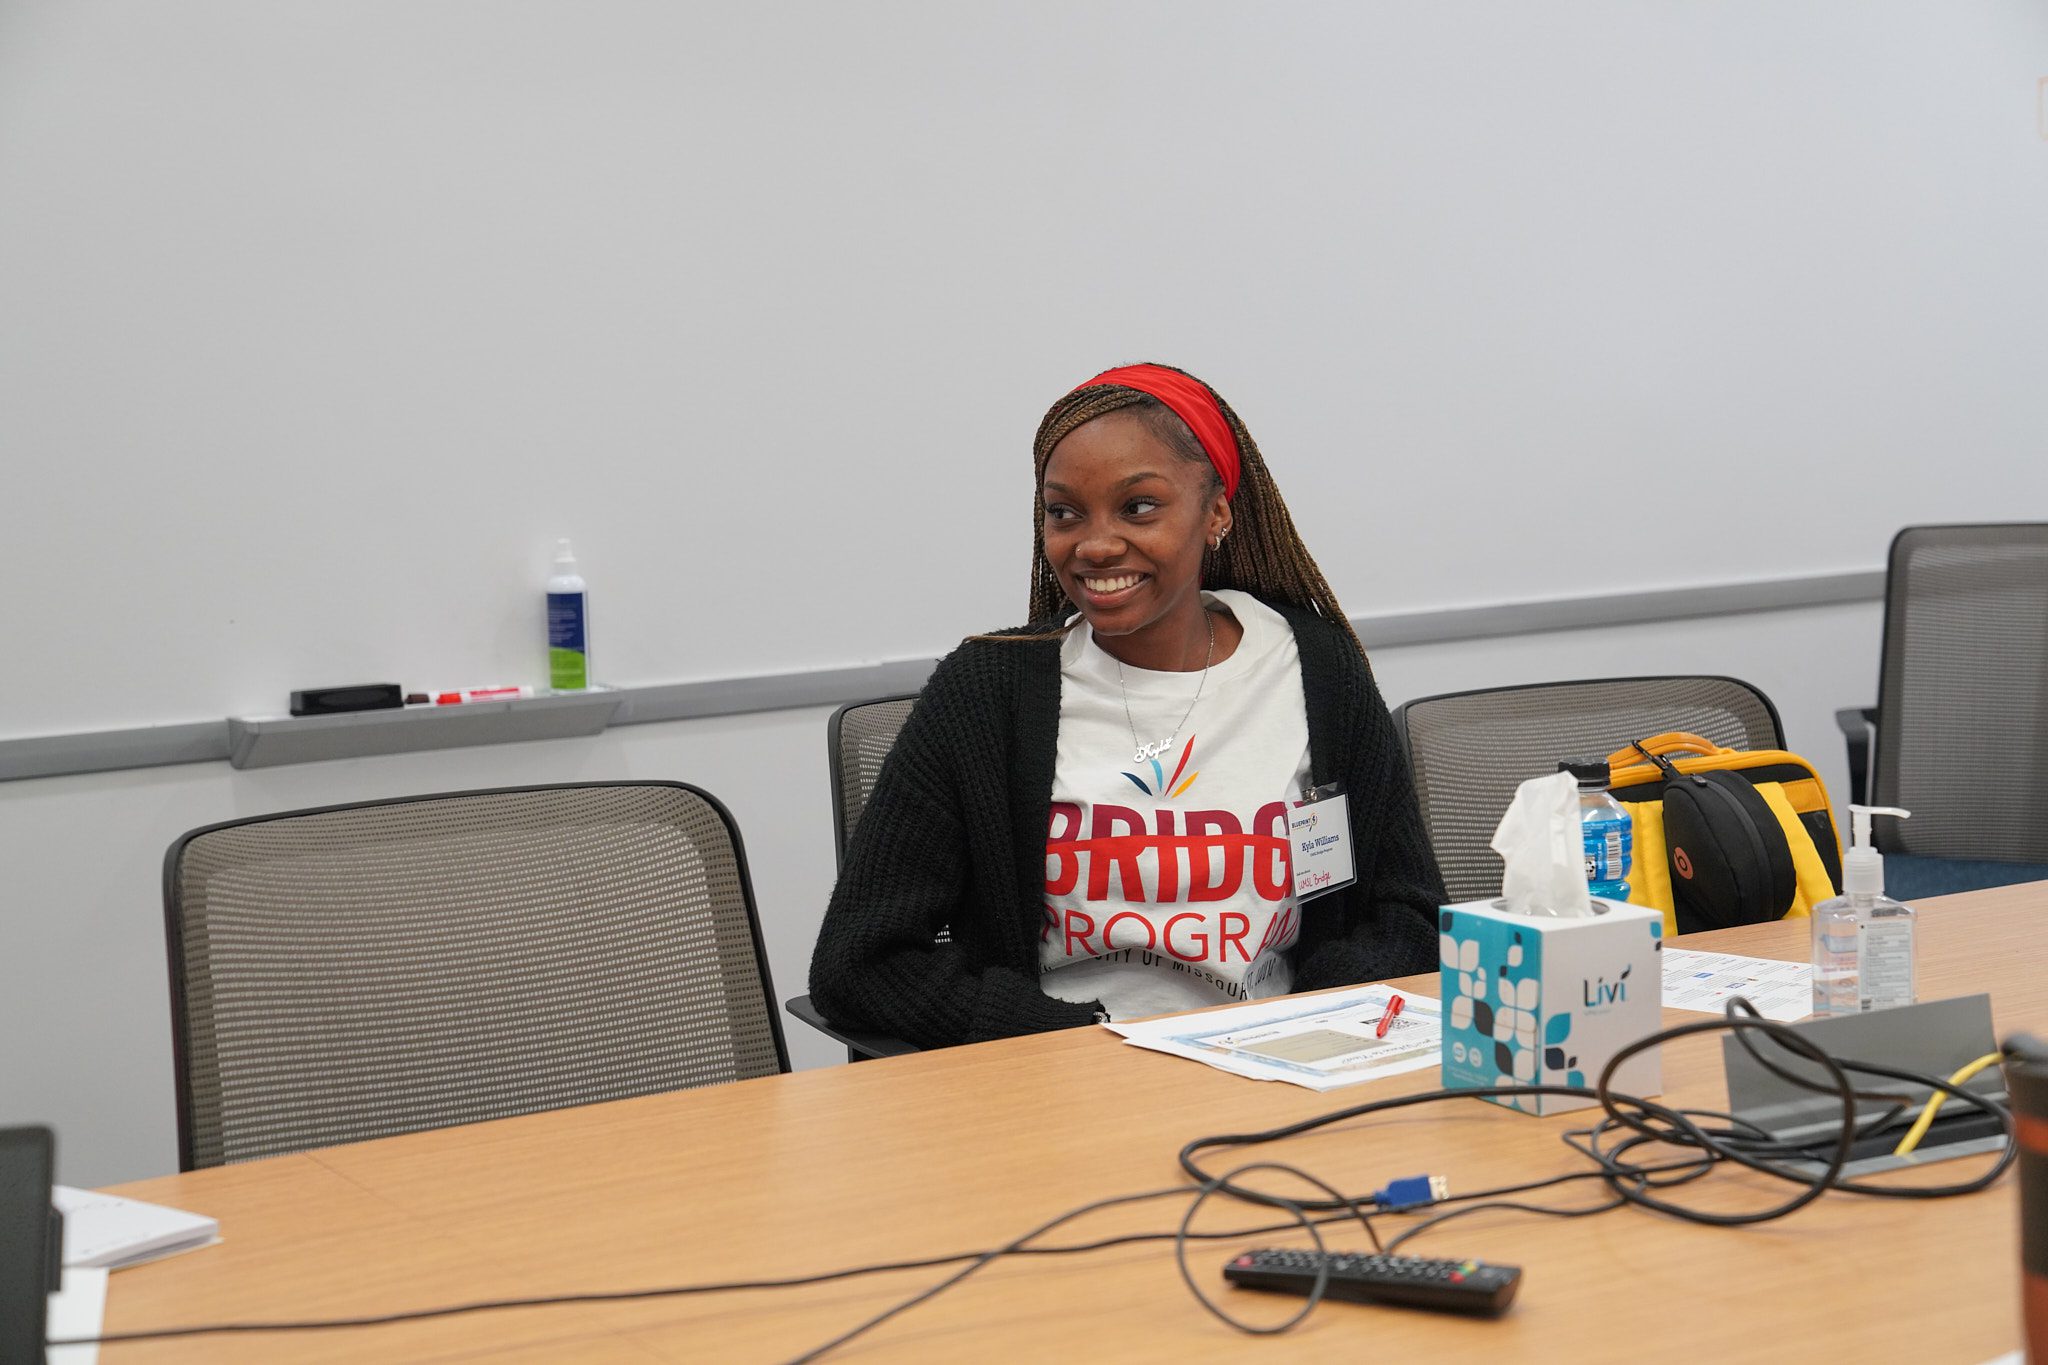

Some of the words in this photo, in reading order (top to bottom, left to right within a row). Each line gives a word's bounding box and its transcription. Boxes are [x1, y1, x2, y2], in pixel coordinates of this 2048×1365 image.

[1045, 801, 1306, 903] BRIDG
[1301, 840, 1315, 853] Kyla
[1314, 834, 1340, 847] Williams
[1312, 869, 1331, 887] Bridge
